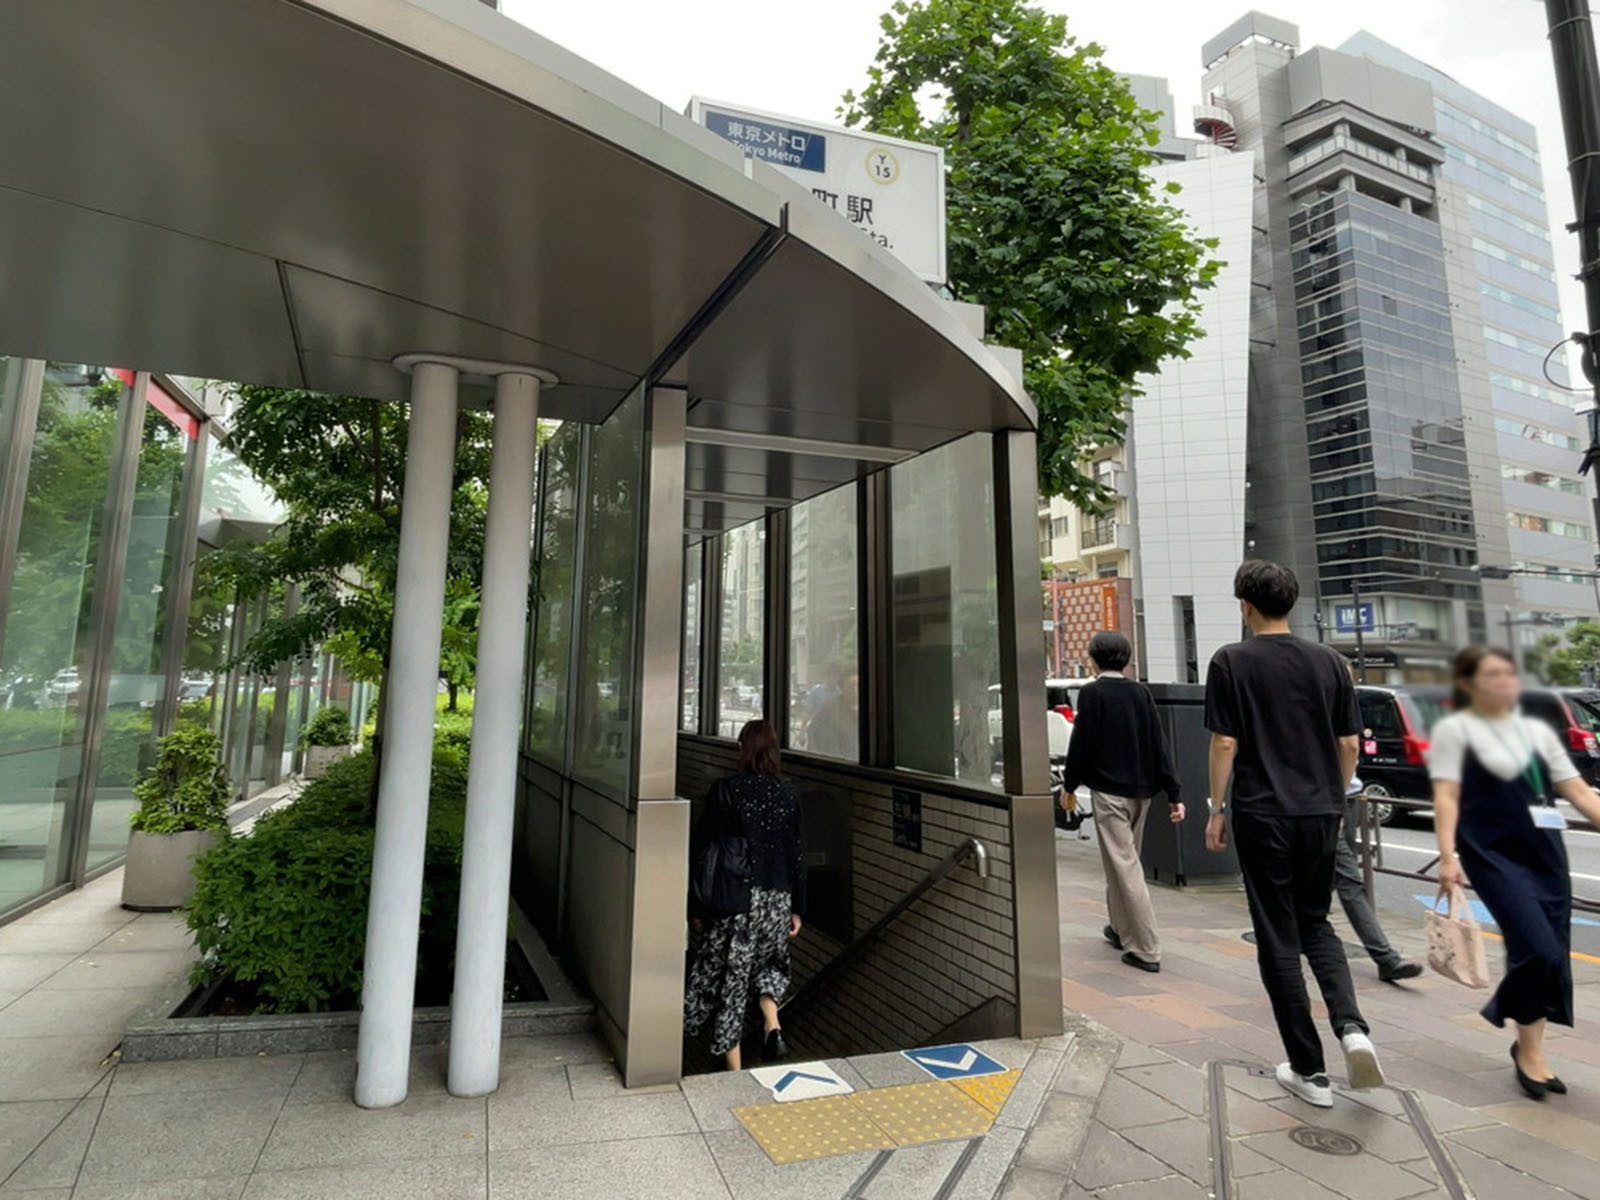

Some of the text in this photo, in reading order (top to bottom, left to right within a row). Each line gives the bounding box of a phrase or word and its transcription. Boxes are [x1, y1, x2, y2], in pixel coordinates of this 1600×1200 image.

[728, 122, 805, 151] 東京メトロ
[767, 147, 801, 163] Metro
[878, 154, 887, 164] Y
[876, 165, 891, 178] 15
